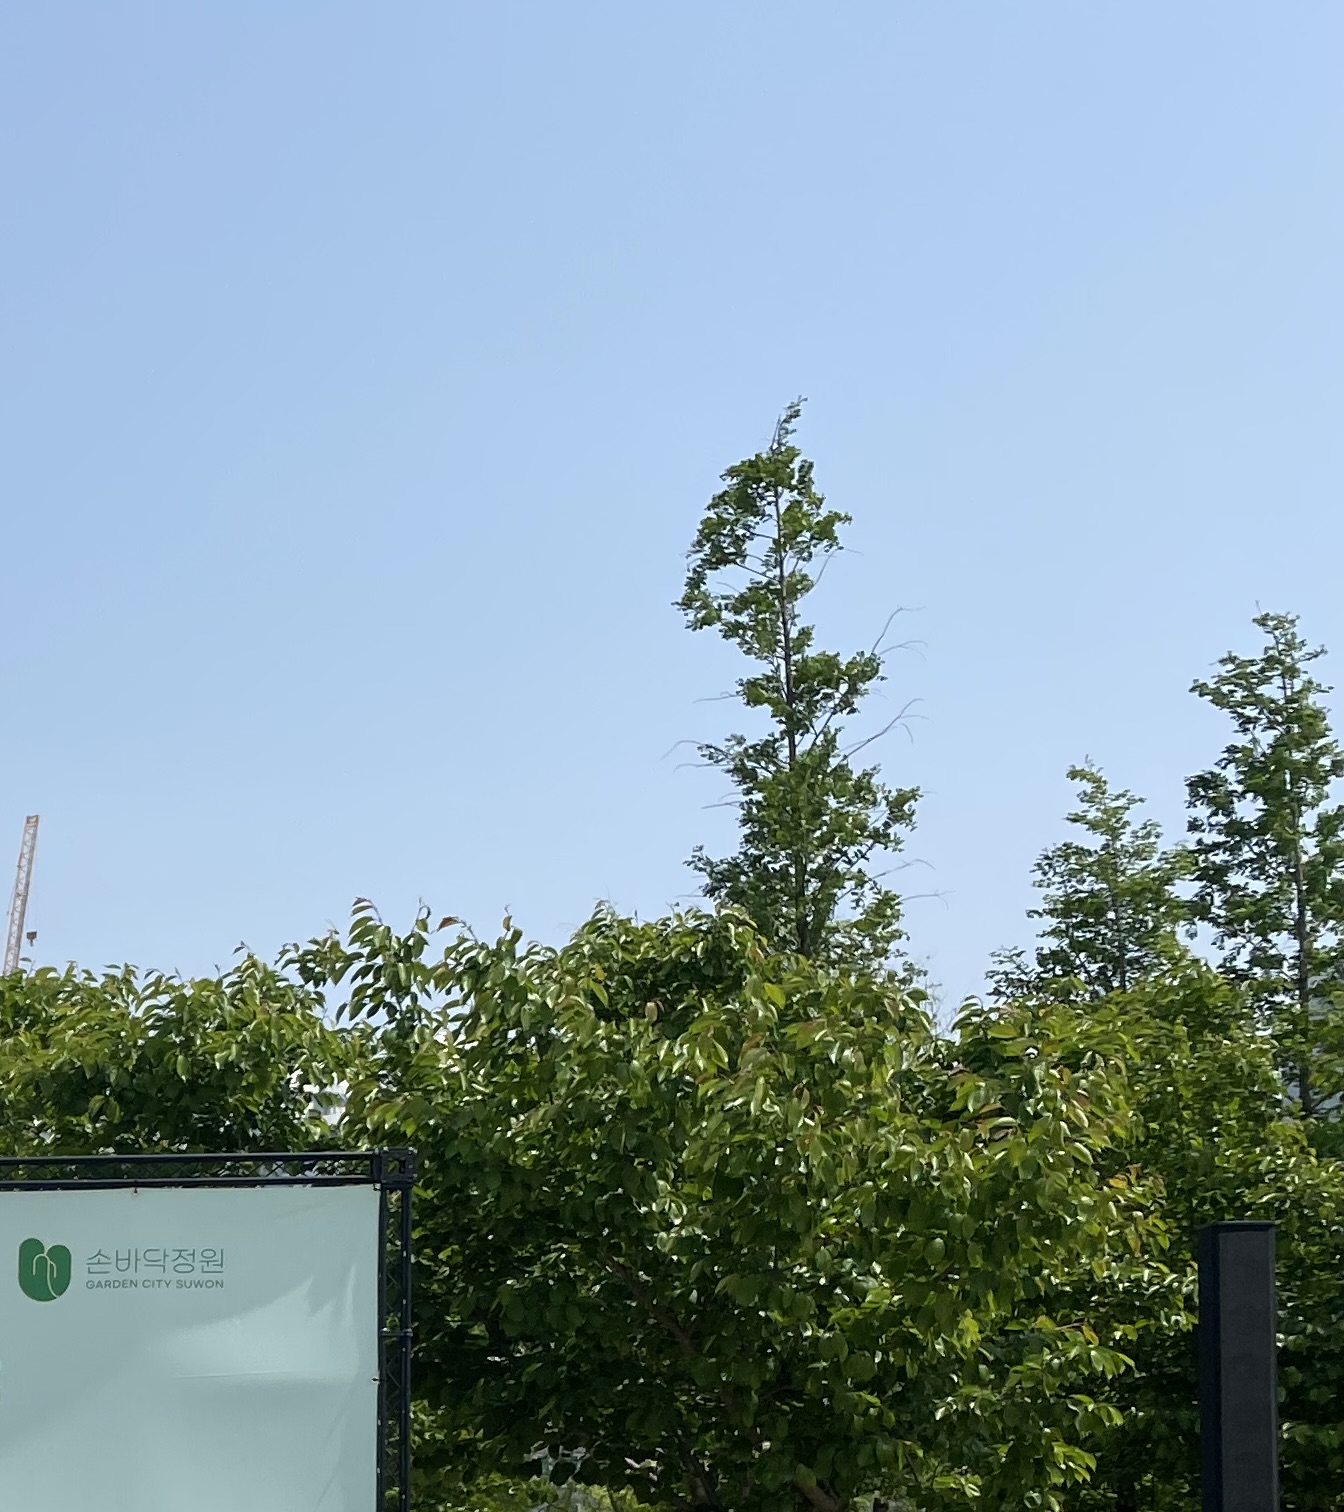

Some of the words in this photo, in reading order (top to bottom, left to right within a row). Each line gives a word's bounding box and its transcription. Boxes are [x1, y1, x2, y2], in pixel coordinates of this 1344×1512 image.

[85, 1248, 225, 1275] 손바닥정원
[85, 1279, 139, 1290] GARDEN
[141, 1279, 173, 1289] CITY
[175, 1279, 225, 1290] SUWON
